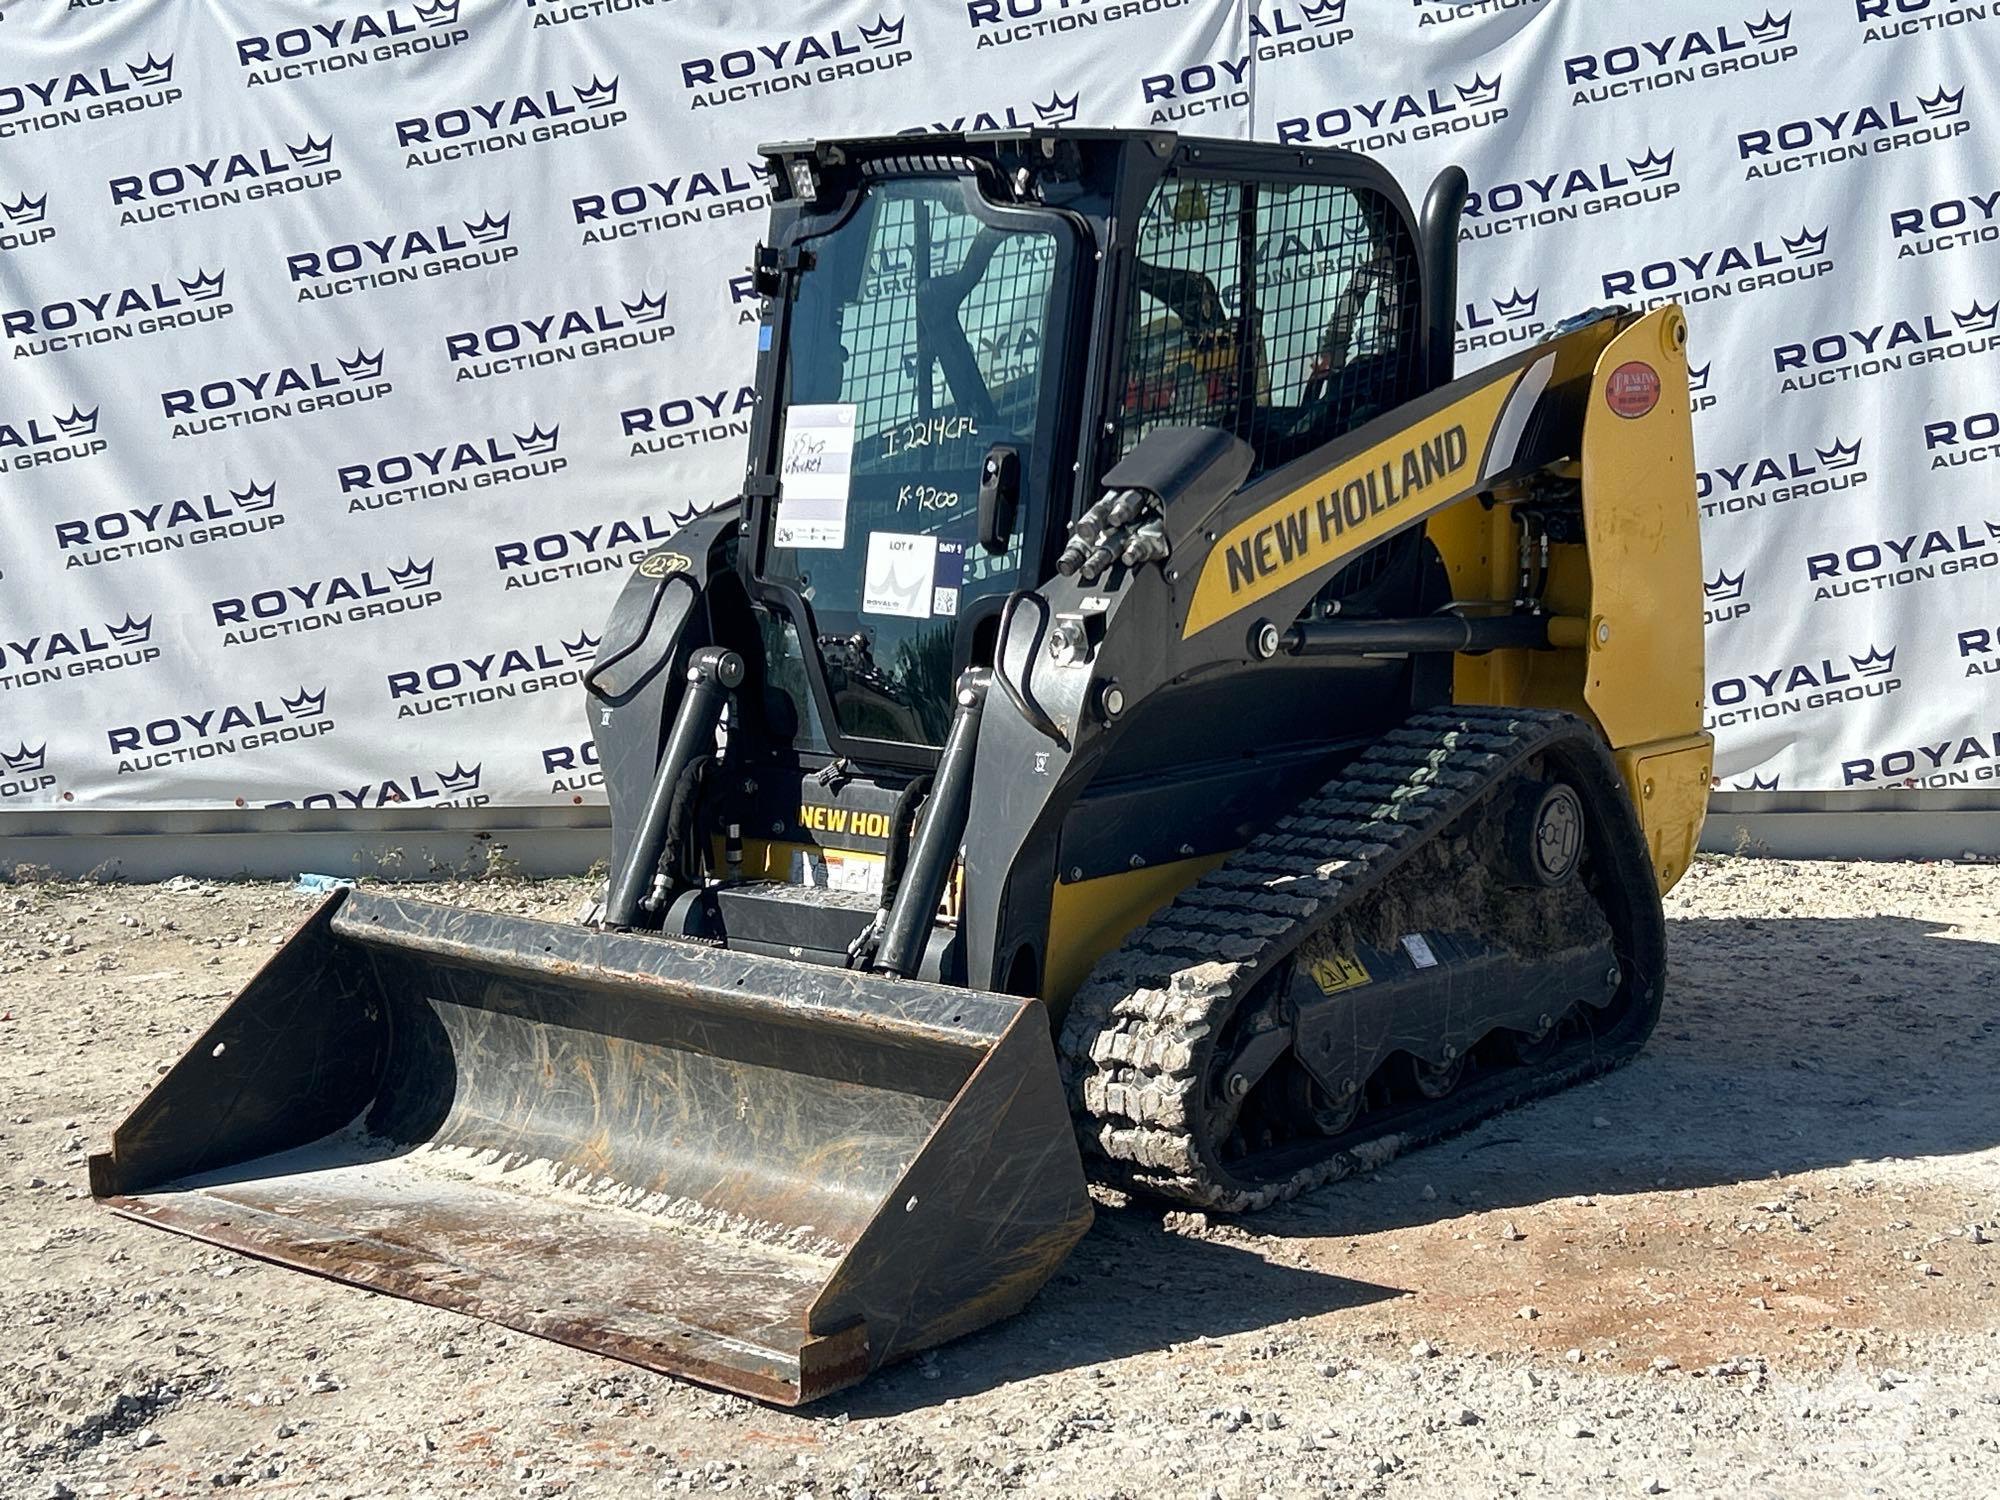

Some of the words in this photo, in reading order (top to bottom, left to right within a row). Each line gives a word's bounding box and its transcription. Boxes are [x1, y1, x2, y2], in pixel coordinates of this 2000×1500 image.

[236, 10, 416, 66] ROYAL
[976, 10, 1098, 49] AUCTION
[1103, 0, 1190, 21] GROU
[1258, 29, 1353, 61] GROUP
[1863, 5, 1986, 44] AUCTION
[247, 51, 368, 87] AUCTION
[373, 30, 469, 61] GROUP
[681, 31, 860, 88] ROYAL
[691, 72, 811, 110] AUCTION
[817, 51, 912, 82] GROUP
[1142, 55, 1250, 103] ROY
[1564, 26, 1746, 85] ROYAL
[1573, 67, 1694, 106] AUCTION
[1701, 46, 1797, 78] GROUP
[0, 68, 130, 116] OYAL
[0, 109, 81, 137] CTION
[87, 89, 182, 119] GROUP
[396, 91, 575, 147] ROYAL
[1150, 91, 1250, 125] AUCTIO
[1276, 89, 1456, 146] ROYAL
[406, 131, 526, 169] AUCTION
[532, 111, 627, 142] GROUP
[1328, 130, 1407, 152] TION
[1413, 108, 1508, 140] GROUP
[1738, 101, 1918, 159] ROYAL
[1746, 142, 1867, 181] AUCTION
[1874, 121, 1970, 153] GROUP
[109, 149, 289, 205] ROYAL
[120, 190, 241, 226] AUCTION
[246, 170, 341, 200] GROUP
[572, 168, 750, 224] ROYAL
[1462, 163, 1629, 217] ROYAL
[0, 227, 56, 250] OUP
[583, 208, 702, 245] AUCTION
[708, 193, 772, 218] GRO
[1458, 204, 1578, 243] AUCTION
[1583, 182, 1681, 215] GROUP
[1890, 191, 2000, 238] ROY
[287, 226, 466, 281] ROYAL
[1898, 226, 2000, 259] AUCTIO
[298, 266, 418, 302] AUCTION
[424, 247, 518, 277] GROUP
[1602, 241, 1782, 299] ROYAL
[1627, 282, 1731, 311] UCTION
[1738, 260, 1834, 292] GROUP
[2, 284, 182, 338] ROYAL
[14, 324, 133, 359] AUCTION
[139, 304, 233, 334] GROUP
[446, 306, 624, 361] ROYAL
[1454, 322, 1545, 354] GROUP
[456, 346, 575, 382] AUCTION
[581, 326, 675, 356] GROUP
[1774, 316, 1952, 373] ROYAL
[161, 363, 341, 418] ROYAL
[1781, 356, 1902, 393] AUCTION
[173, 403, 291, 439] AUCTION
[297, 383, 392, 413] GROUP
[620, 386, 756, 436] ROYA
[14, 440, 107, 469] GROUP
[338, 438, 516, 493] ROYAL
[631, 421, 748, 457] AUCTION
[1931, 444, 2000, 470] AUCT
[349, 477, 468, 513] AUCTION
[474, 458, 567, 487] GROUP
[1696, 453, 1817, 498] YAL
[1701, 493, 1767, 517] TION
[1772, 472, 1867, 503] GROUP
[55, 495, 233, 549] ROYAL
[1225, 507, 1308, 594] NEW
[1316, 424, 1468, 545] HOLLAND
[66, 534, 184, 569] AUCTION
[190, 515, 284, 544] GROUP
[495, 516, 671, 570] ROYAL
[889, 541, 906, 551] LOT
[1807, 526, 1985, 581] ROYAL
[212, 572, 390, 626] ROYAL
[505, 555, 623, 590] AUCTION
[1814, 565, 1934, 601] AUCTION
[1941, 553, 1999, 575] GRO
[224, 611, 342, 647] AUCTION
[348, 592, 442, 621] GROUP
[0, 628, 108, 669] YAL
[0, 667, 62, 690] TION
[67, 648, 160, 677] GROUP
[388, 645, 563, 699] ROYAL
[398, 683, 516, 719] AUCTION
[521, 669, 584, 693] GRO
[1703, 699, 1801, 730] UCTION
[1807, 679, 1901, 708] GROUP
[1711, 660, 1851, 707] OYAL
[108, 701, 283, 754] ROYAL
[117, 740, 235, 775] AUCTION
[241, 720, 334, 749] GROUP
[0, 775, 57, 797] OUP
[801, 805, 848, 833] NEW
